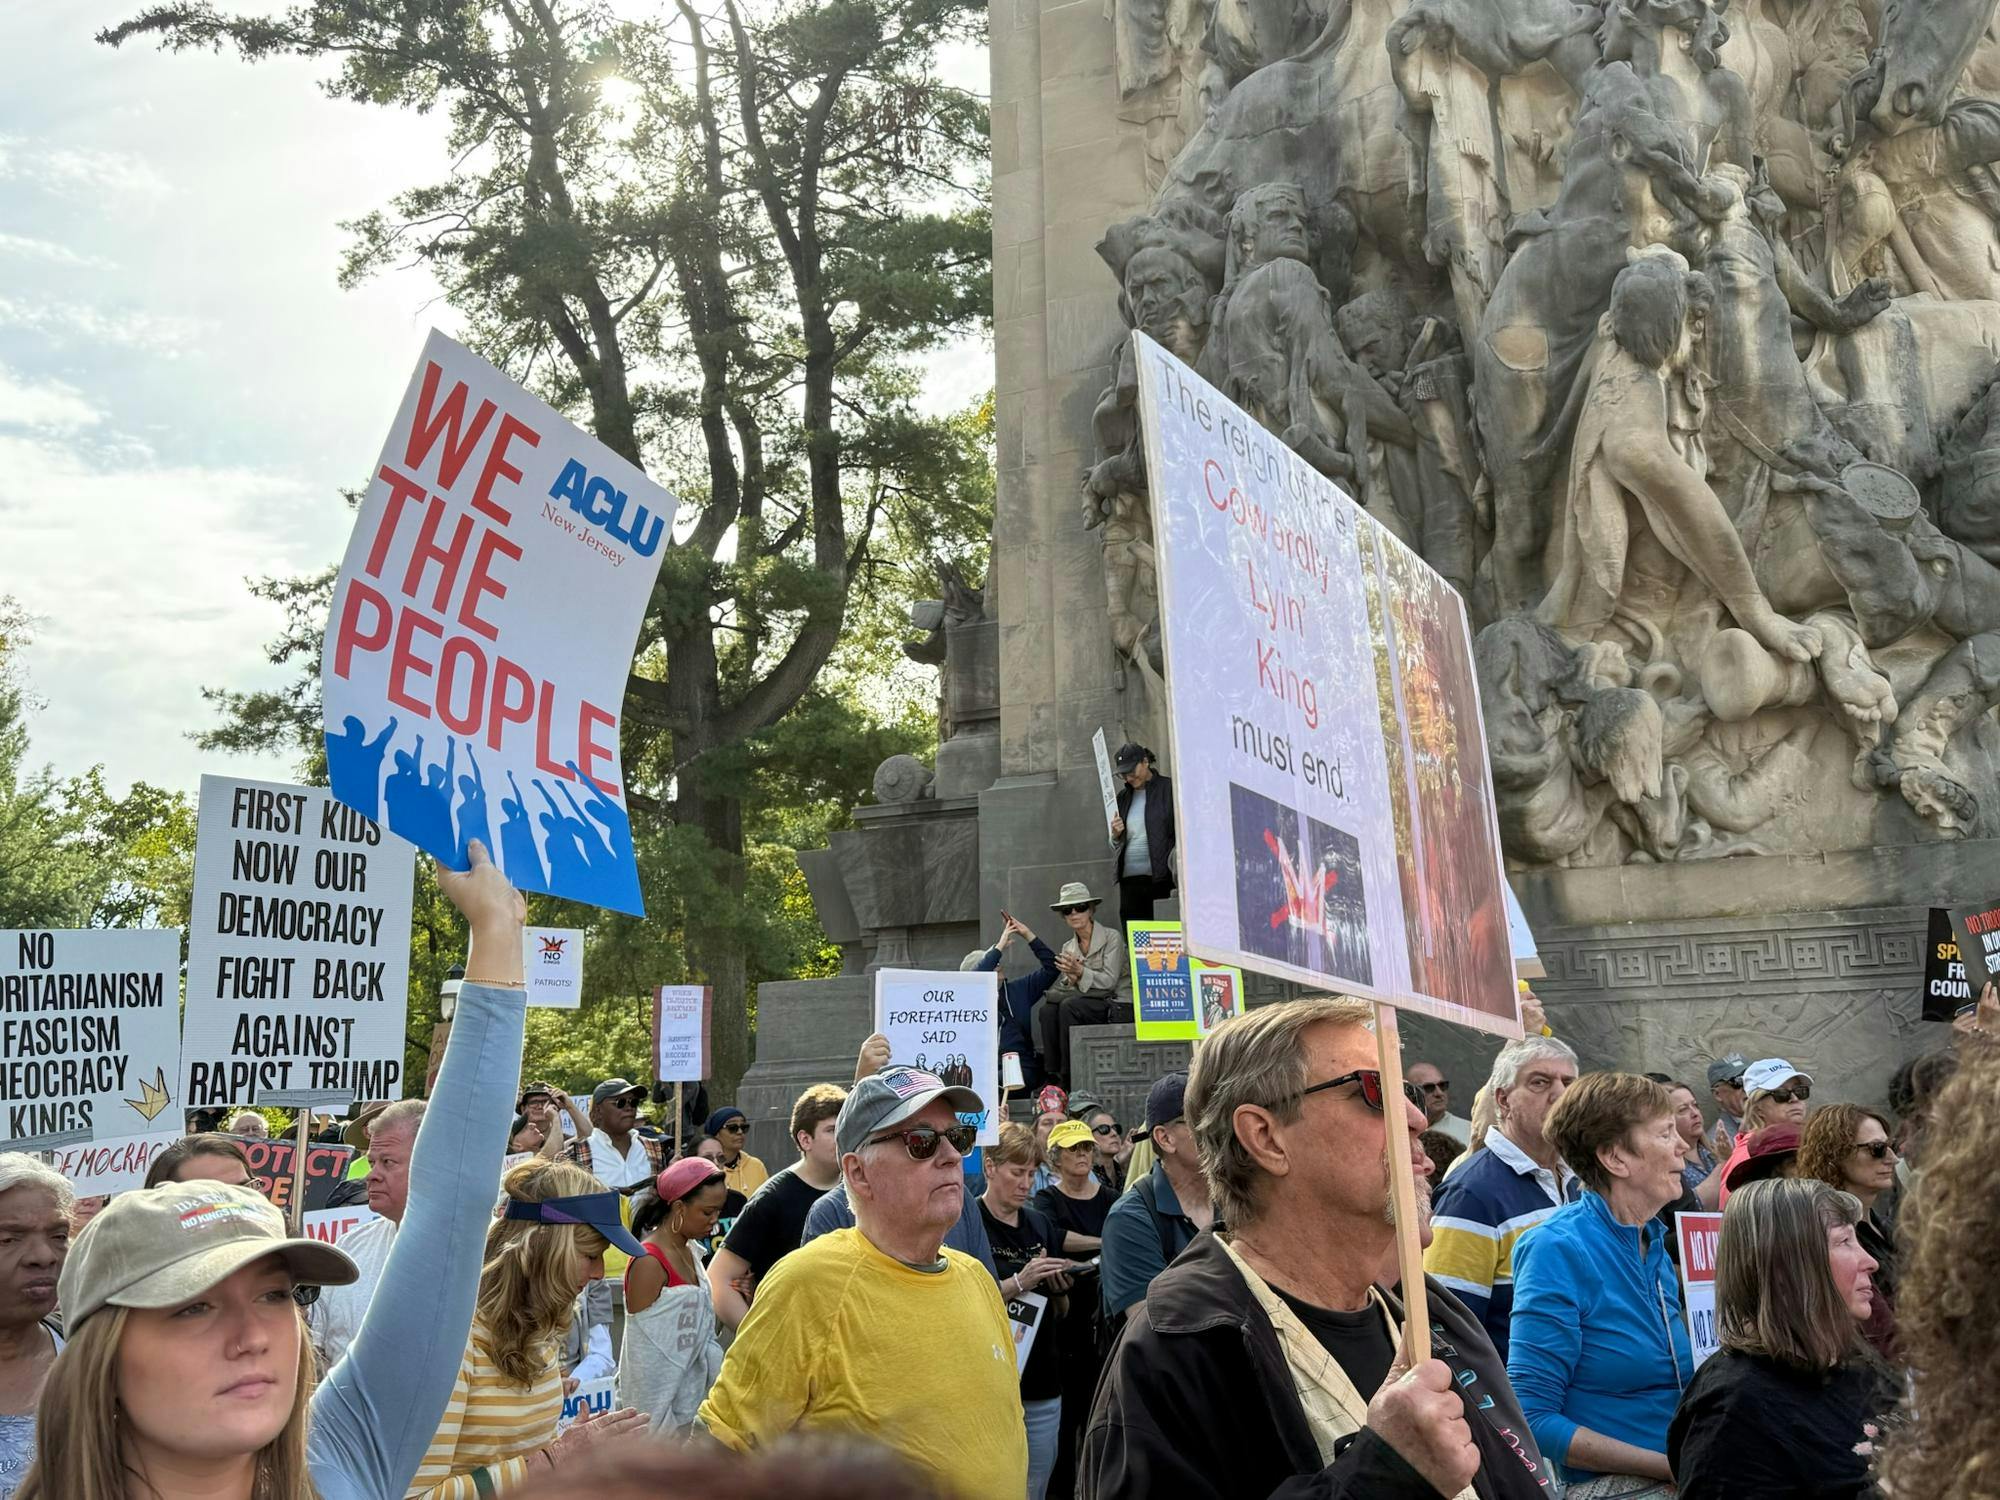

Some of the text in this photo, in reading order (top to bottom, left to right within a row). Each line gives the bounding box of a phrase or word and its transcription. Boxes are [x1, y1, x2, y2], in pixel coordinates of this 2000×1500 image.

[405, 360, 541, 527] WE
[1157, 354, 1212, 432] The
[1220, 415, 1282, 488] reign
[1288, 471, 1309, 508] of
[548, 457, 665, 557] ACLU
[1203, 458, 1329, 595] Cowardly
[364, 464, 523, 642] THE
[541, 501, 626, 568] New Jersey
[1248, 560, 1307, 638] Lyin'
[333, 578, 620, 797] PEOPLE
[1256, 637, 1319, 730] King
[1231, 713, 1351, 804] must end.
[231, 787, 382, 847] FIRST KIDS
[232, 839, 367, 893] NOW OUR
[217, 891, 385, 948] DEMOCRACY
[1964, 914, 1981, 936] NO
[18, 932, 55, 970] NO
[543, 952, 561, 961] NO
[1981, 934, 1994, 953] IN
[0, 972, 164, 1014] RITARIANISM
[216, 955, 386, 1002] FIGHT BACK
[534, 979, 573, 987] PATRIOTS!
[922, 990, 956, 1003] OUR
[1146, 978, 1185, 986] REJECTING
[1146, 987, 1187, 999] KINGS
[889, 1009, 989, 1026] FOREFATHERS
[1150, 1000, 1170, 1008] SINCE
[3, 1016, 120, 1058] FASCISM
[231, 1012, 356, 1060] AGAINST
[921, 1030, 958, 1044] SAID
[188, 1060, 400, 1106] RAPIST TRUMP
[10, 1100, 94, 1140] KINGS
[180, 1214, 198, 1230] NO
[198, 1207, 230, 1224] KINGS
[1689, 1230, 1706, 1272] NO
[1692, 1310, 1707, 1349] NO
[559, 1390, 612, 1421] ACLU
